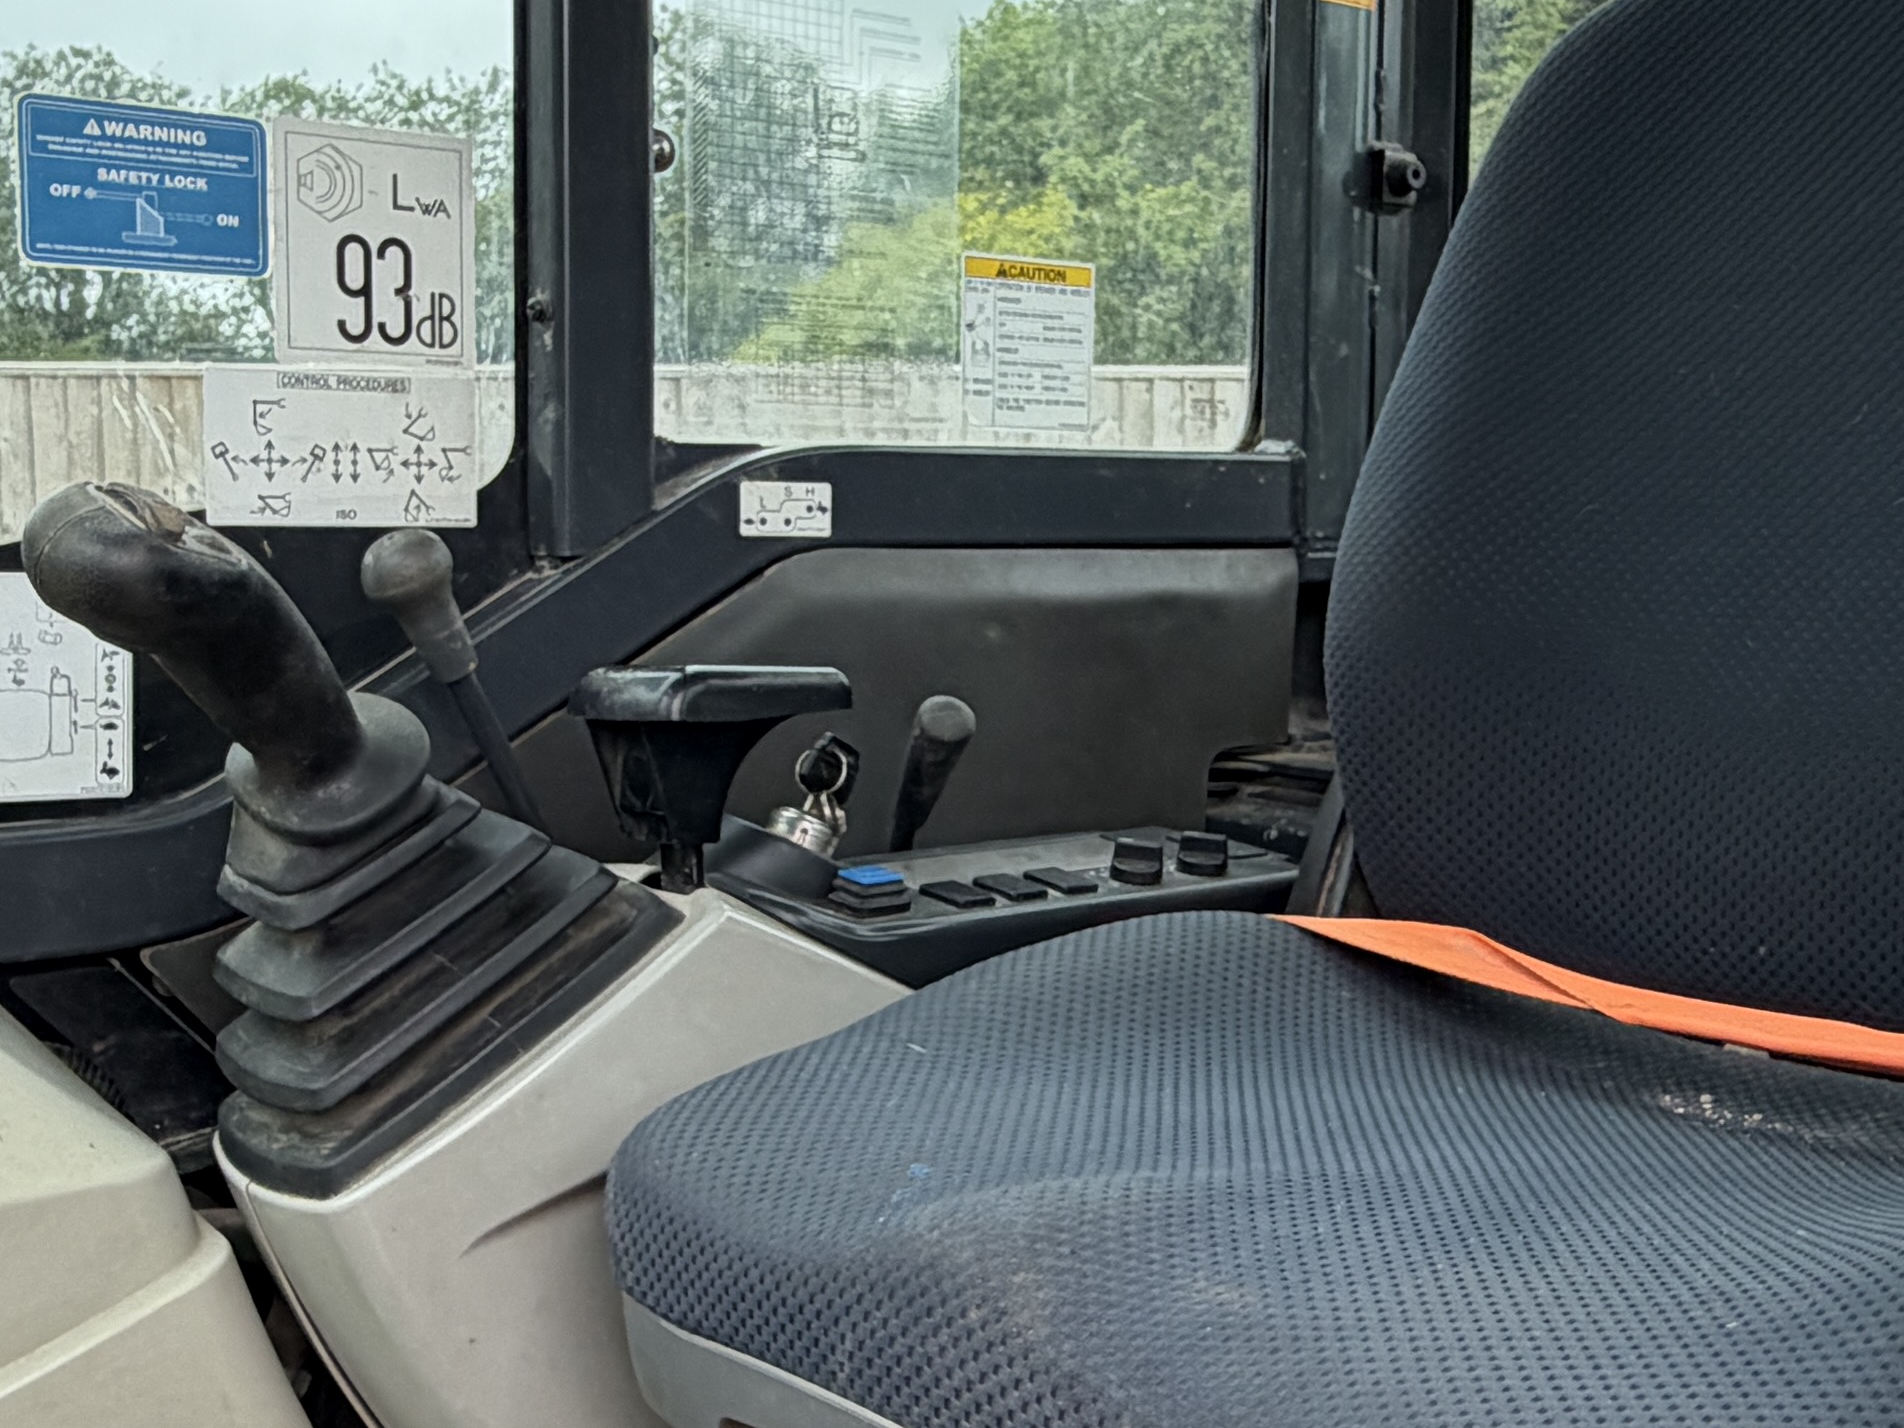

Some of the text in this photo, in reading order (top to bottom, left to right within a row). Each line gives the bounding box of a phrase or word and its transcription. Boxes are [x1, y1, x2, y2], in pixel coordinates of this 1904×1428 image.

[103, 120, 207, 146] WARNING
[97, 167, 208, 191] SAFETY LOCK
[49, 183, 82, 198] OFF
[216, 213, 240, 228] ON
[1008, 267, 1067, 283] CAUTION
[281, 375, 332, 389] CONTROL
